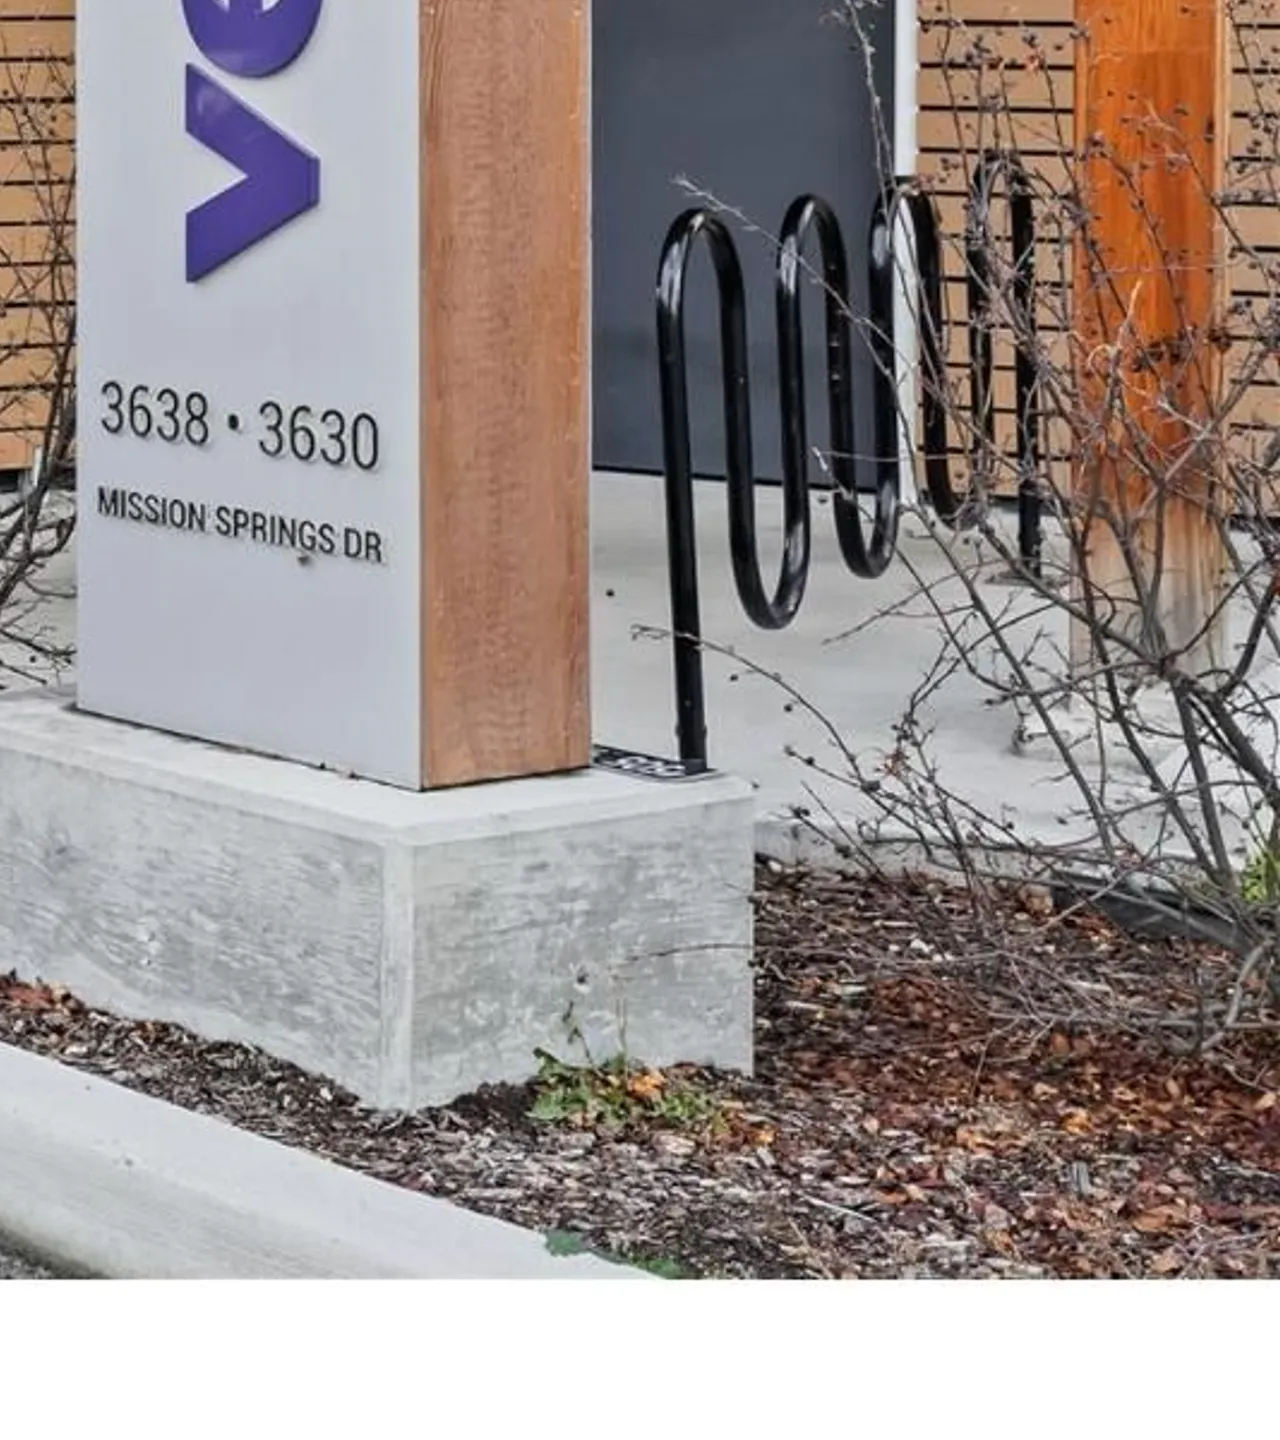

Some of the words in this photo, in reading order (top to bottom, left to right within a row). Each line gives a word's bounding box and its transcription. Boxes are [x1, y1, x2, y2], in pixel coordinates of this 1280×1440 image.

[100, 380, 209, 446] 3638
[258, 401, 379, 470] 3630
[97, 485, 206, 533] MISSION
[215, 506, 336, 555] SPRINGS
[343, 527, 383, 563] DR
